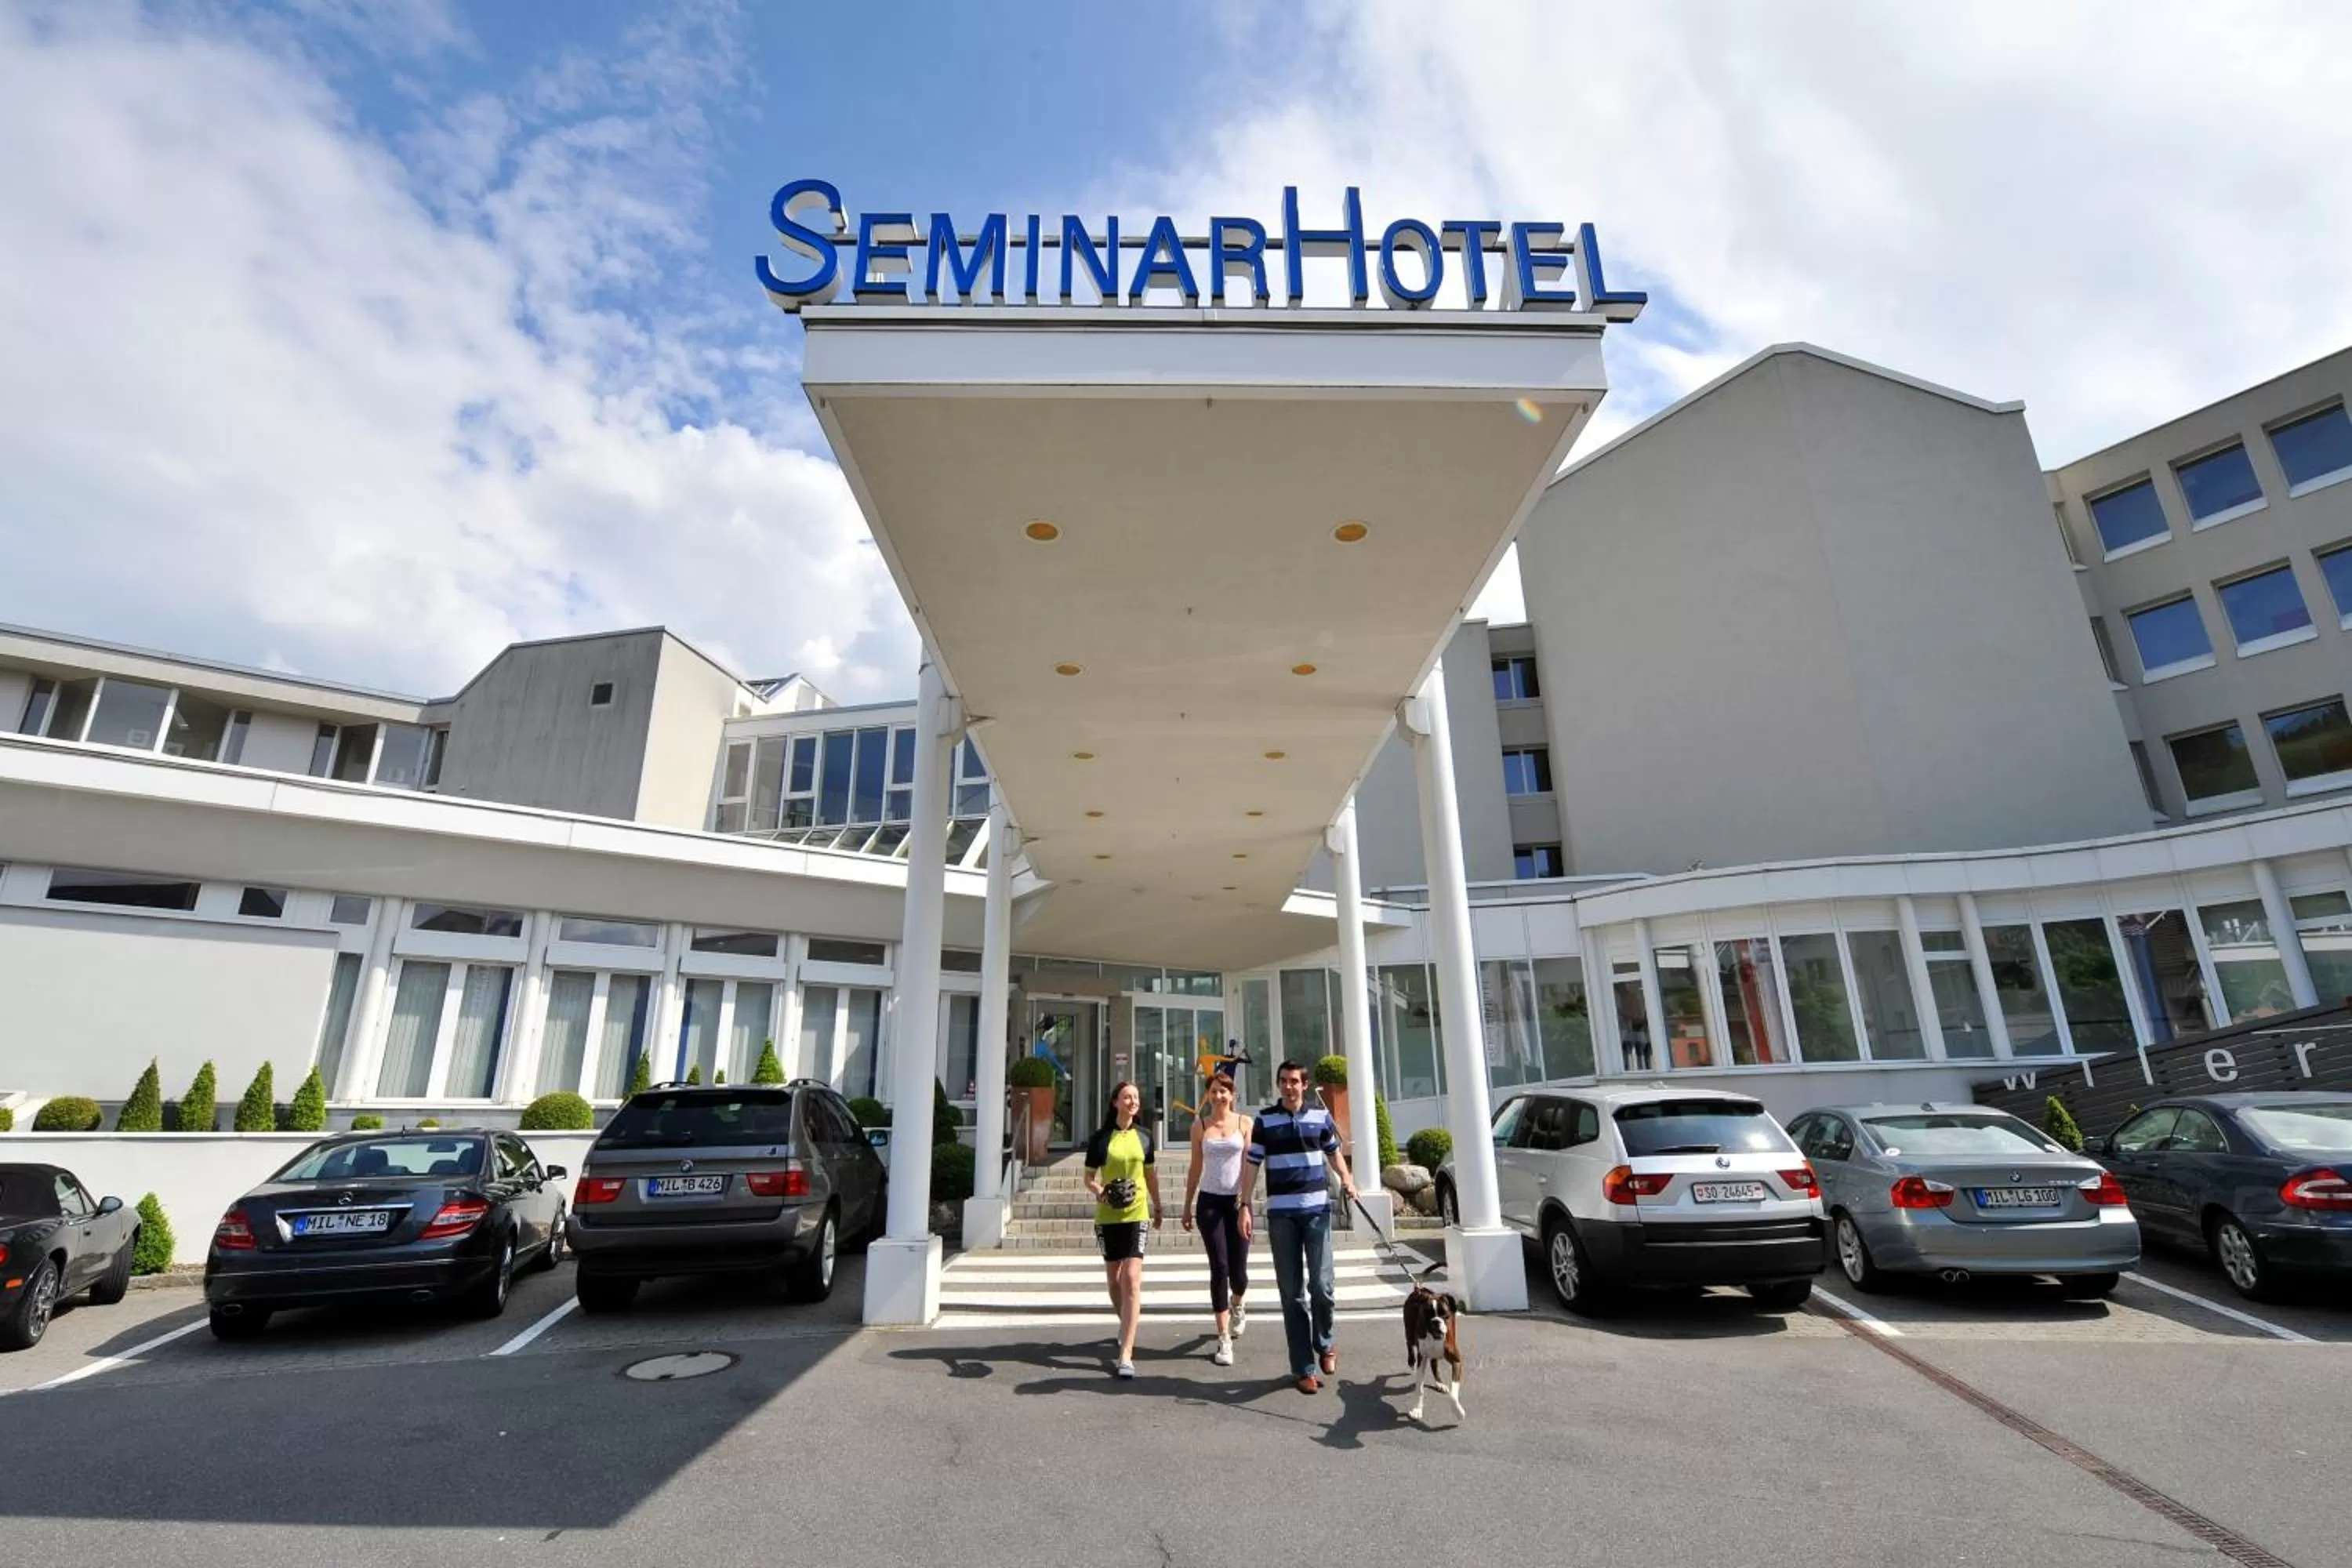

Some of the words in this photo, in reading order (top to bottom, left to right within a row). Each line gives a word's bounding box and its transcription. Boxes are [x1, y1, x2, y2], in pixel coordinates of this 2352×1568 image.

[756, 180, 1647, 323] SEMINARHOTEL
[699, 1178, 721, 1190] 426
[306, 1215, 335, 1229] MIL
[345, 1214, 365, 1226] NE
[367, 1213, 387, 1226] 18
